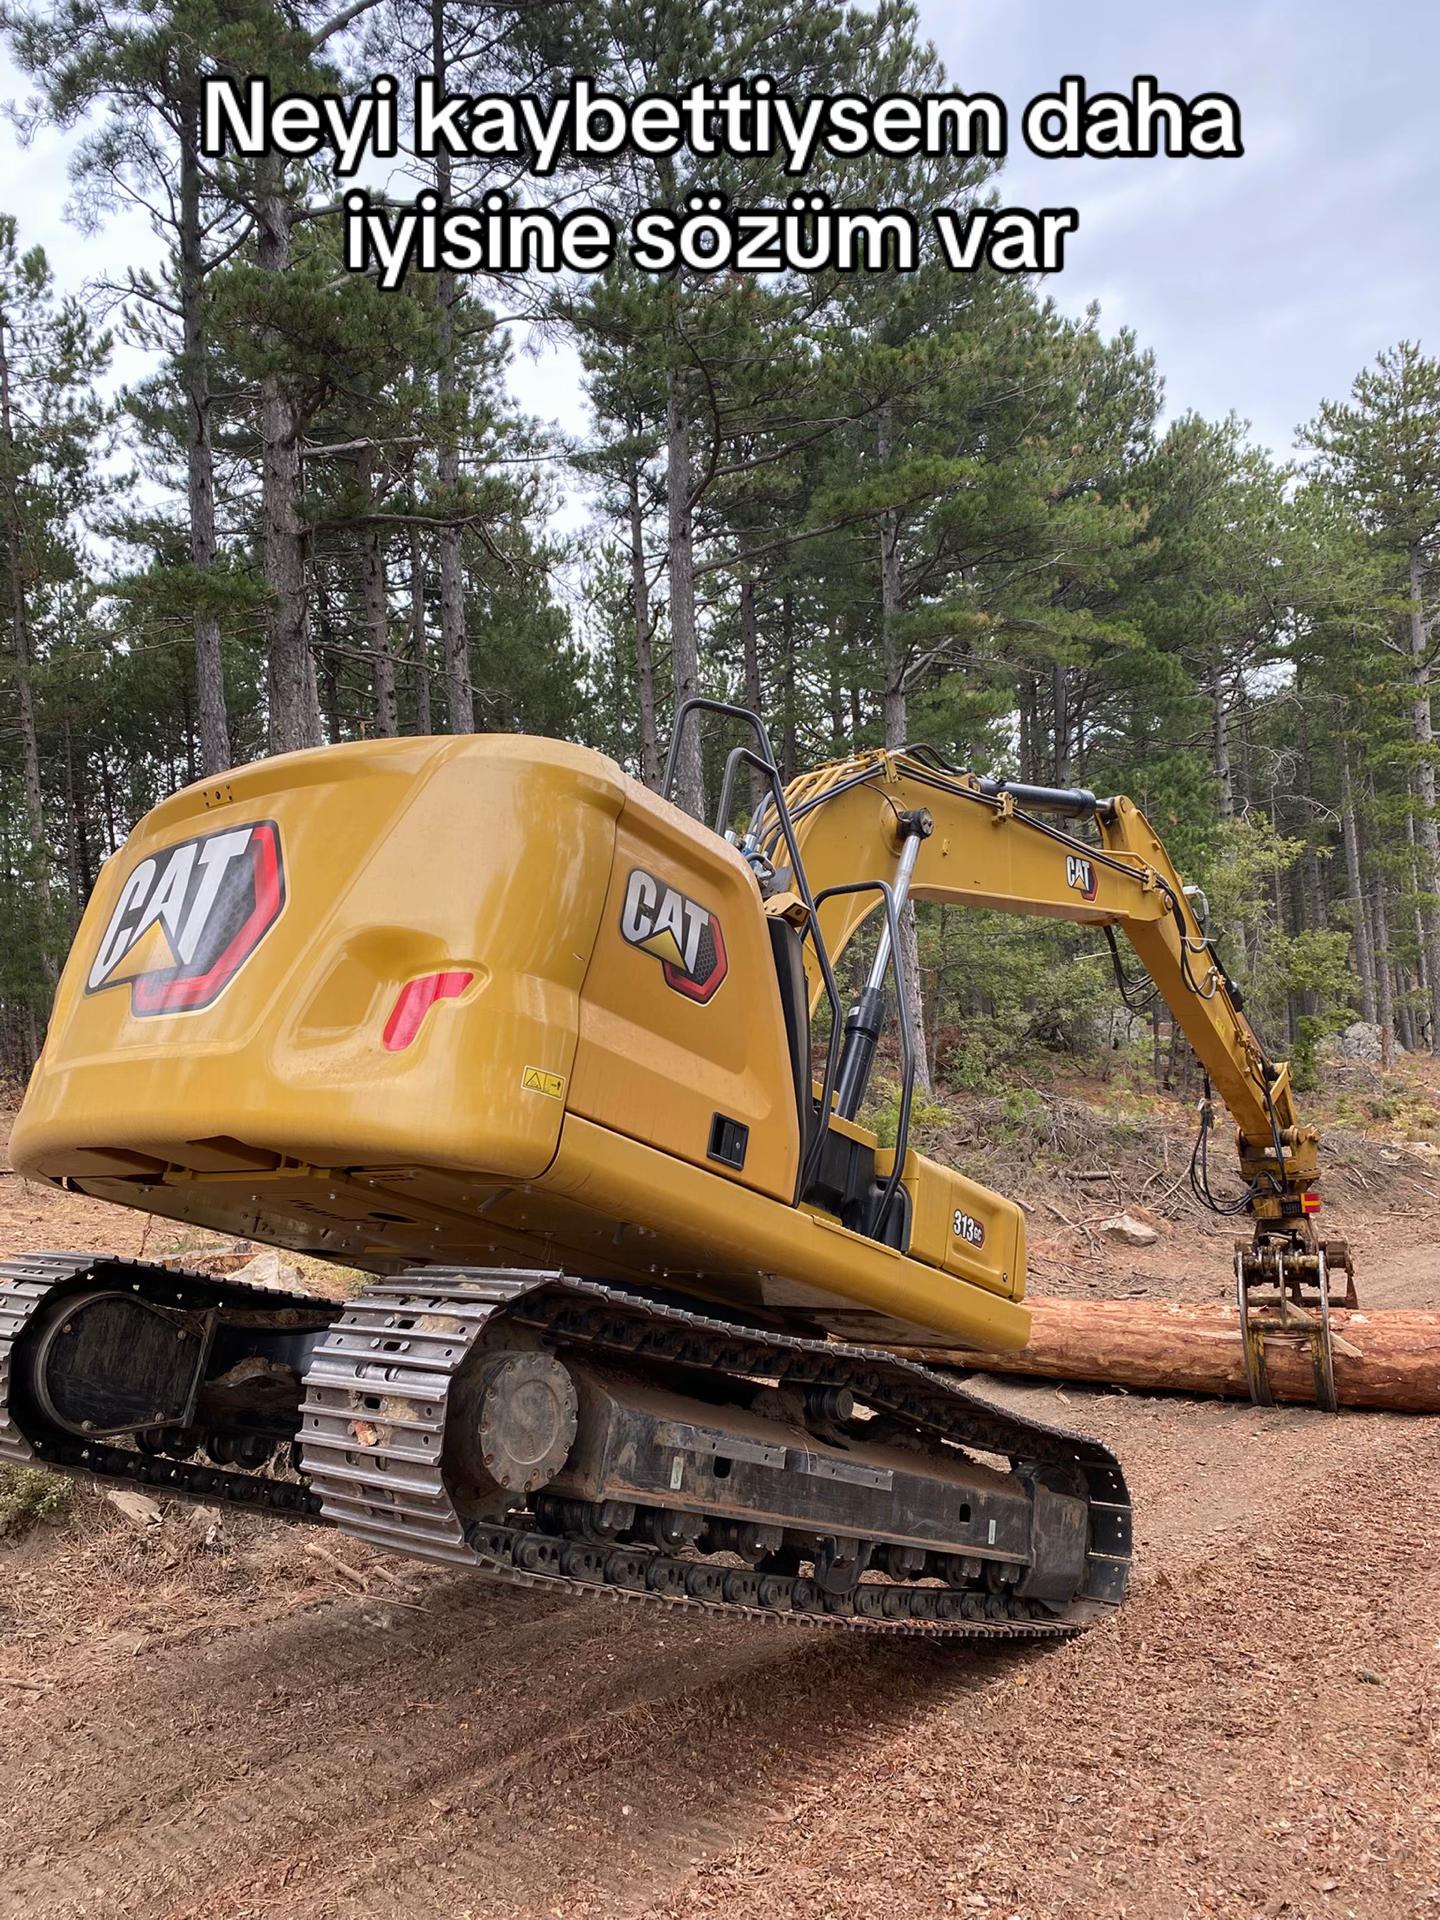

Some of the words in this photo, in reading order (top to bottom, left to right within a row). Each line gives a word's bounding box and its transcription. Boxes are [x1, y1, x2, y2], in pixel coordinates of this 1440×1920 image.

[88, 827, 253, 989] CAT
[622, 869, 710, 974] CAT
[1066, 855, 1090, 891] CAT
